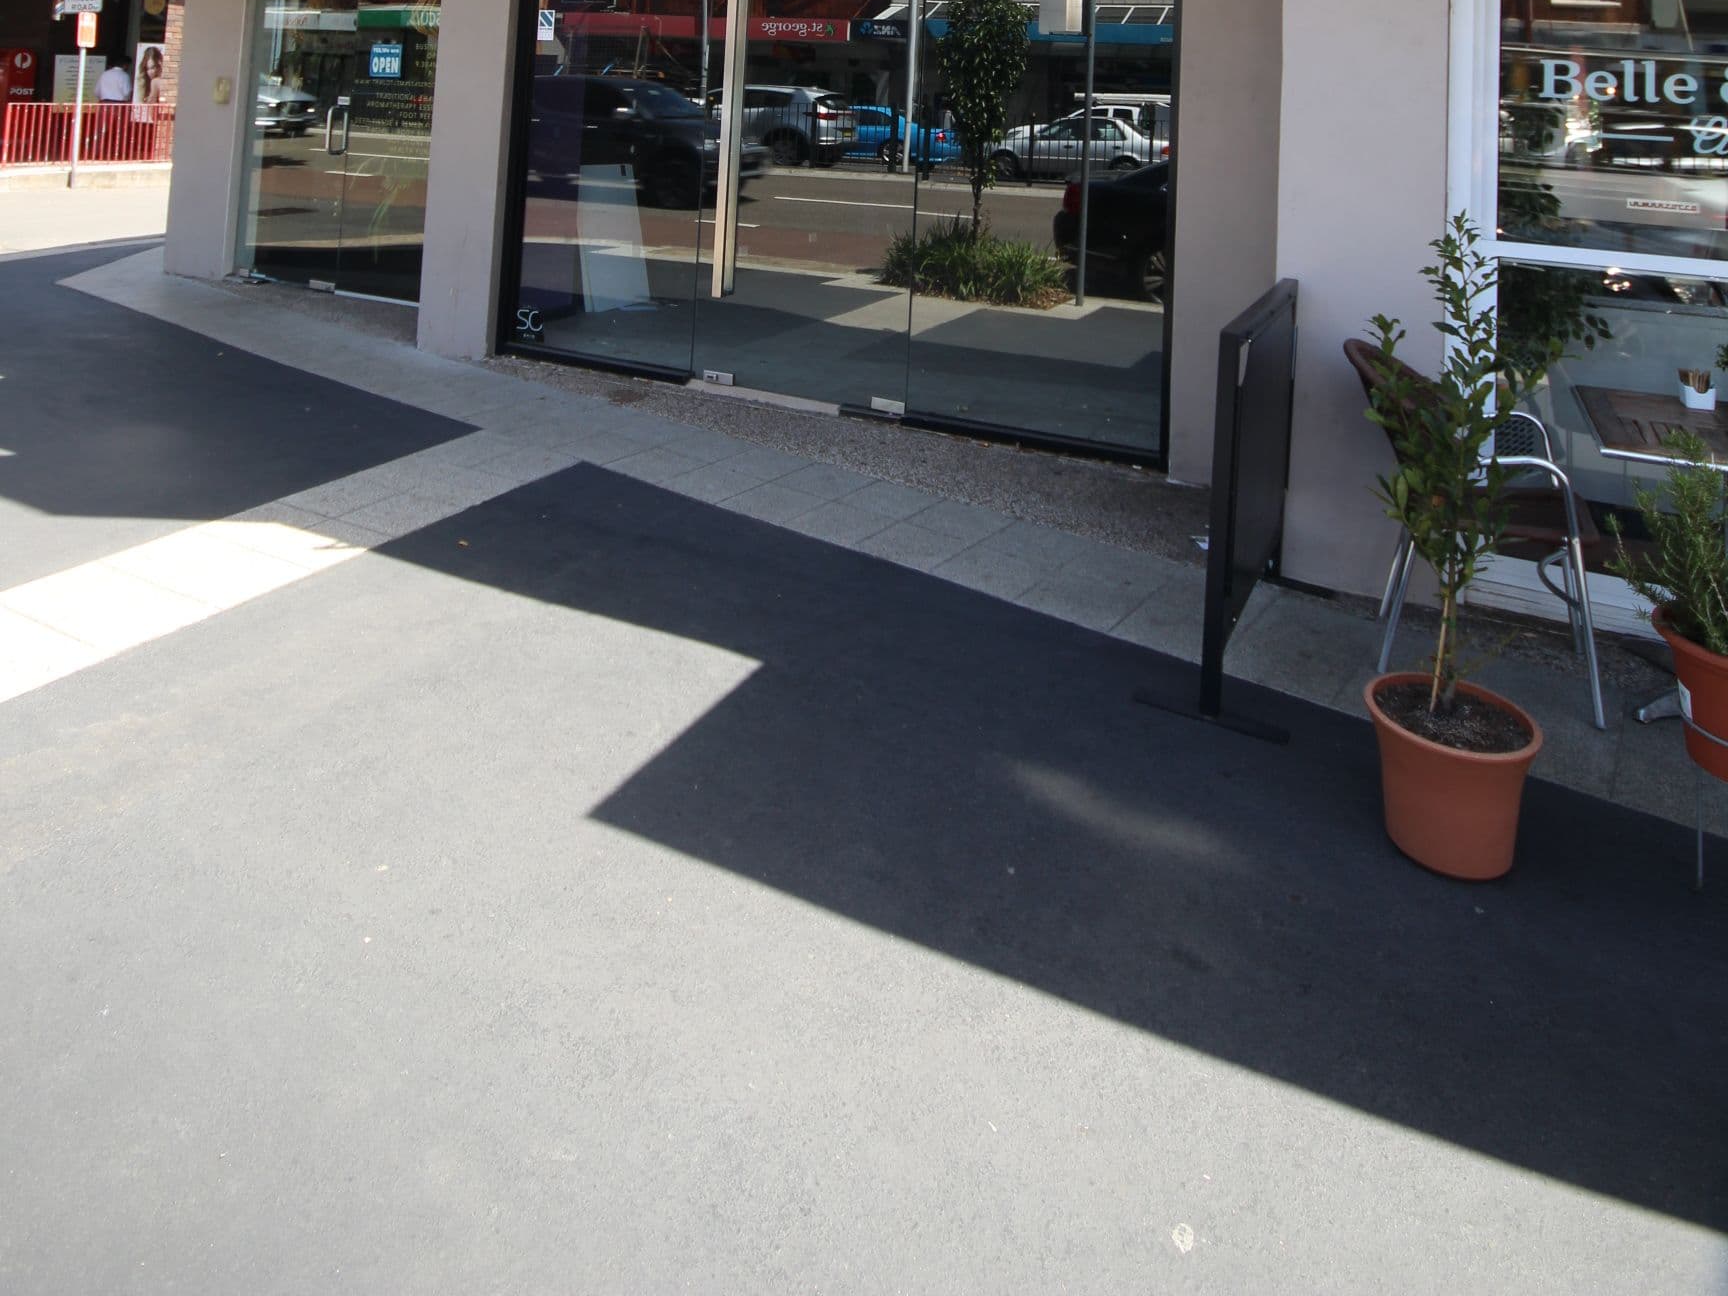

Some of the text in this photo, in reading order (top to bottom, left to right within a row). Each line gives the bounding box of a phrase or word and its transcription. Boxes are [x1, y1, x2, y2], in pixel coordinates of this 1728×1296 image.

[372, 57, 399, 73] OPEN
[1539, 59, 1698, 104] Belle
[9, 88, 35, 96] POST
